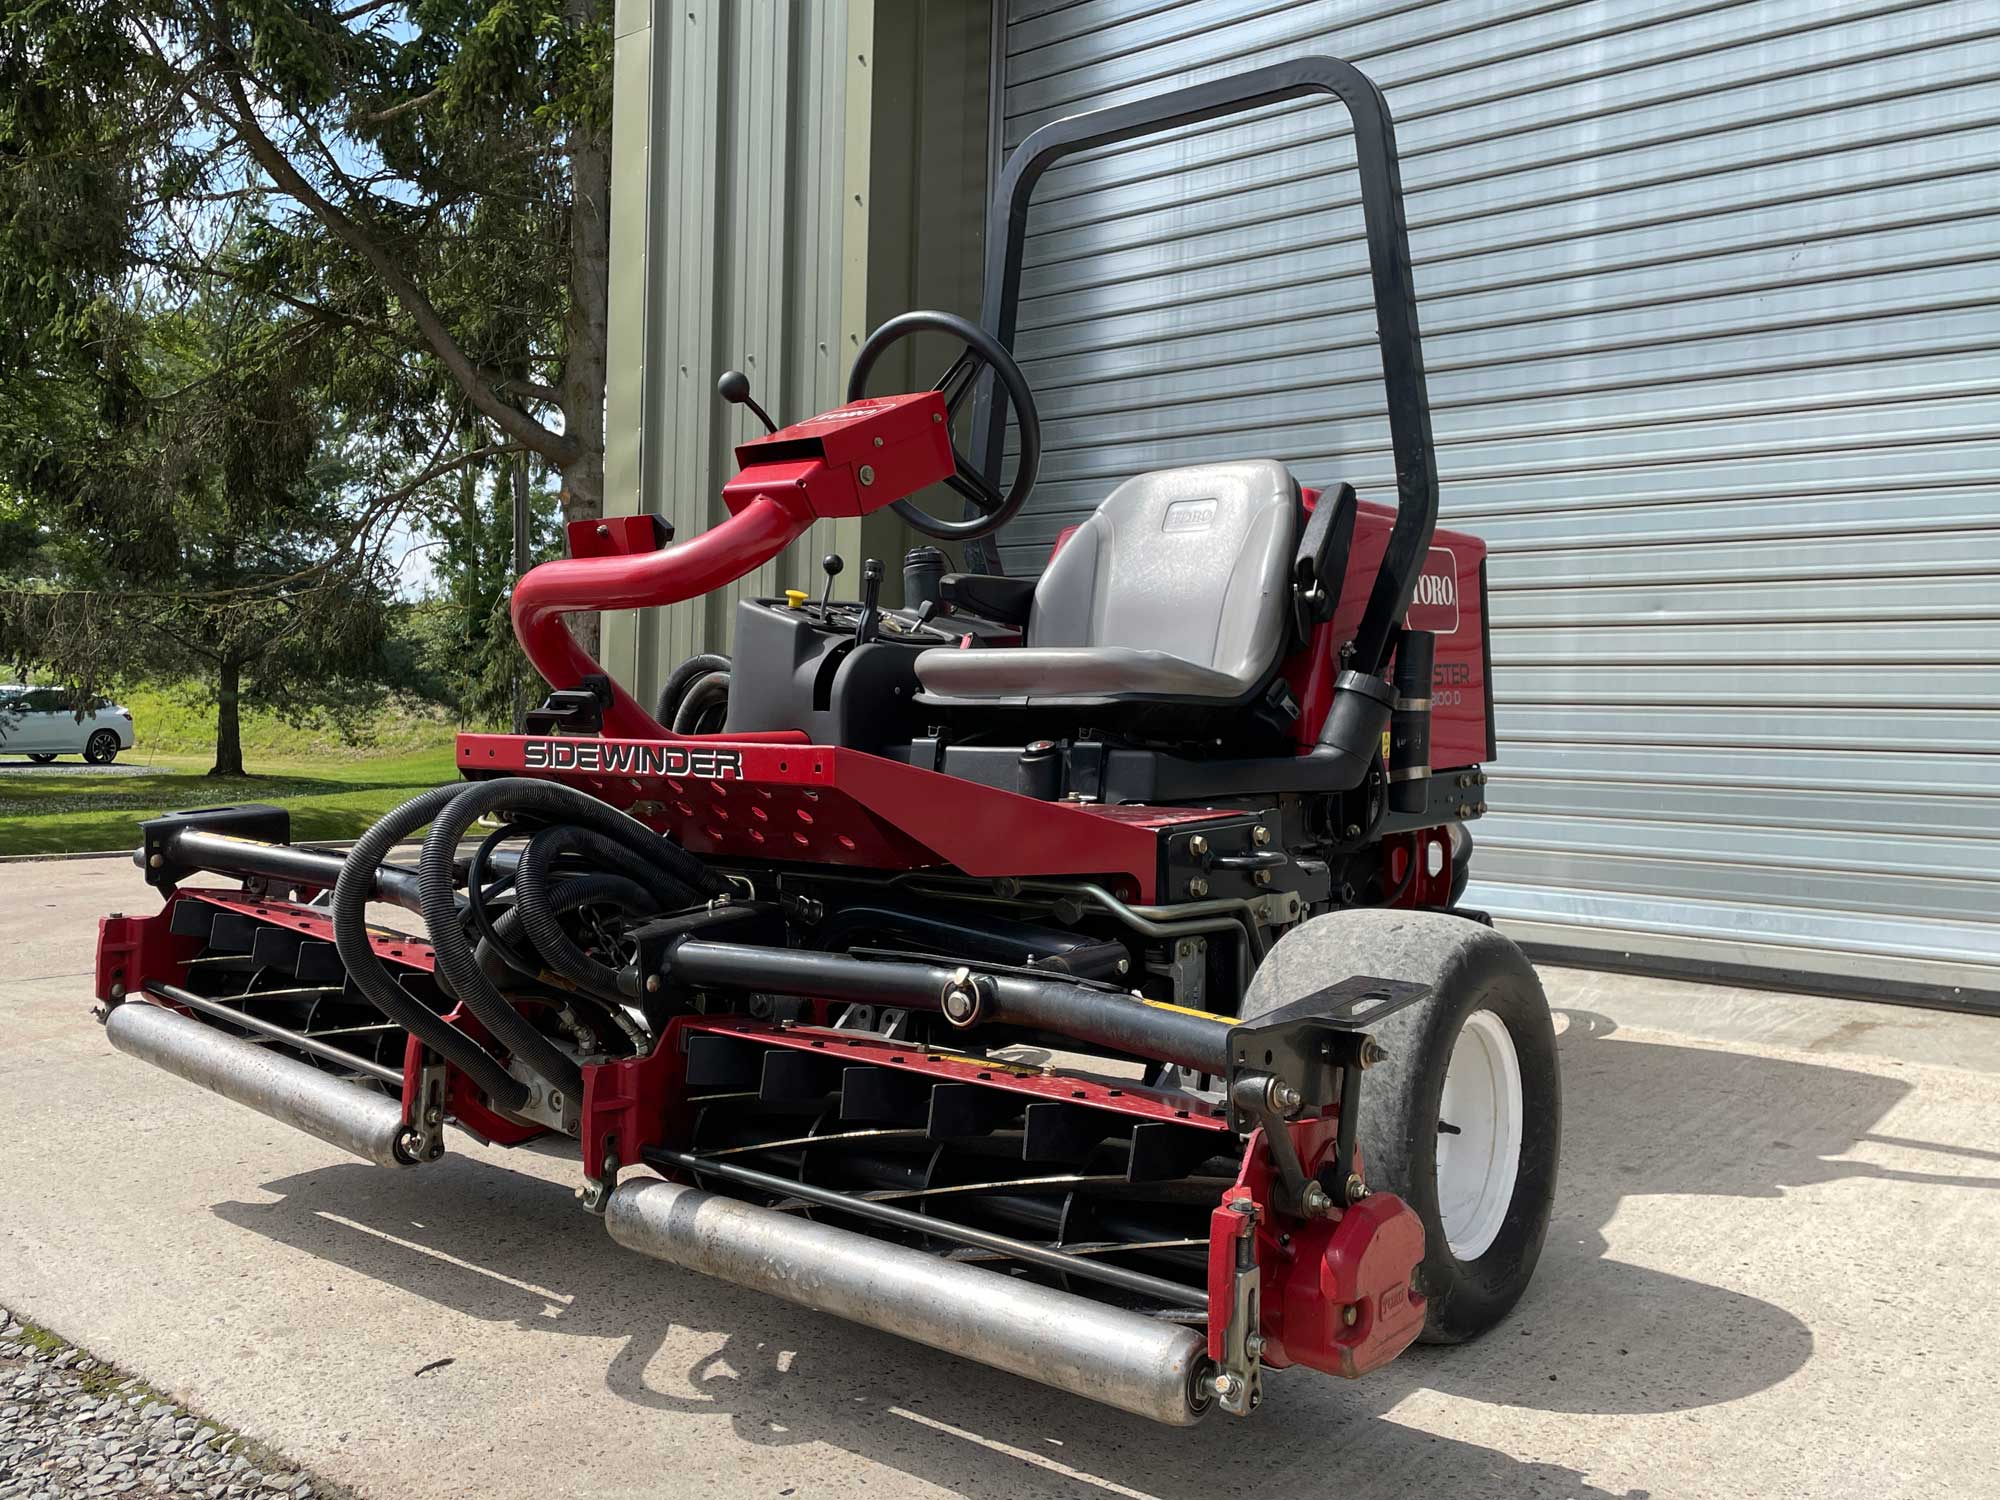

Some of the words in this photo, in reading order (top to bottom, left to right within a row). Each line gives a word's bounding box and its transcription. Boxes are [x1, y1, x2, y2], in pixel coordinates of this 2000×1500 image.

[1432, 663, 1471, 686] STER
[1454, 690, 1462, 705] D
[523, 740, 744, 781] SIDEWINDER
